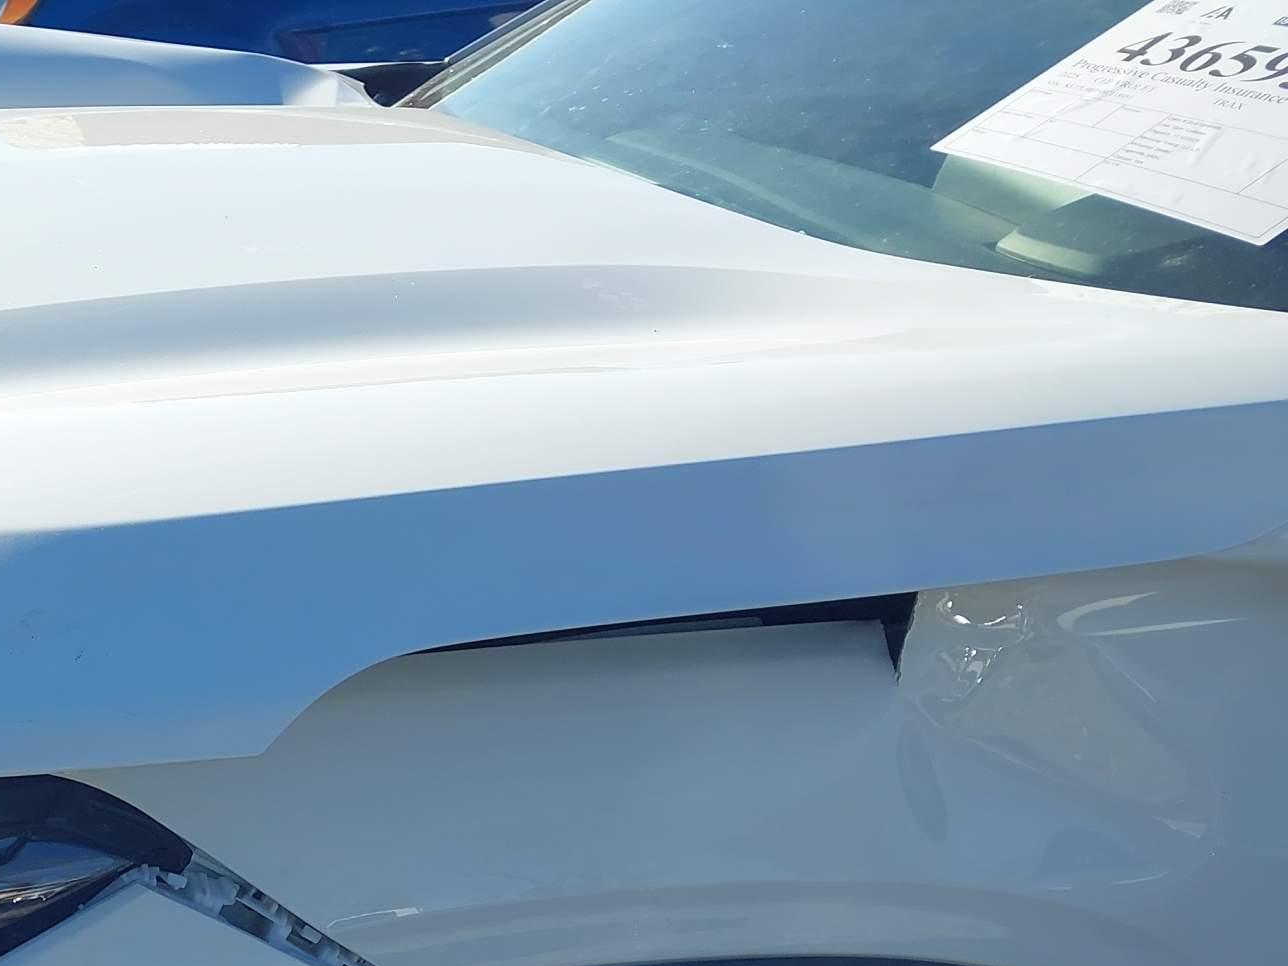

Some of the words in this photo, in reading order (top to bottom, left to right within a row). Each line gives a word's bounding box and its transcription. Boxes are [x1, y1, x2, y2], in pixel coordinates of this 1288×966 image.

[1072, 58, 1150, 79] Progressive
[1151, 70, 1209, 91] Casualty
[1213, 81, 1288, 105] Insurance
[1116, 31, 1288, 89] 43659
